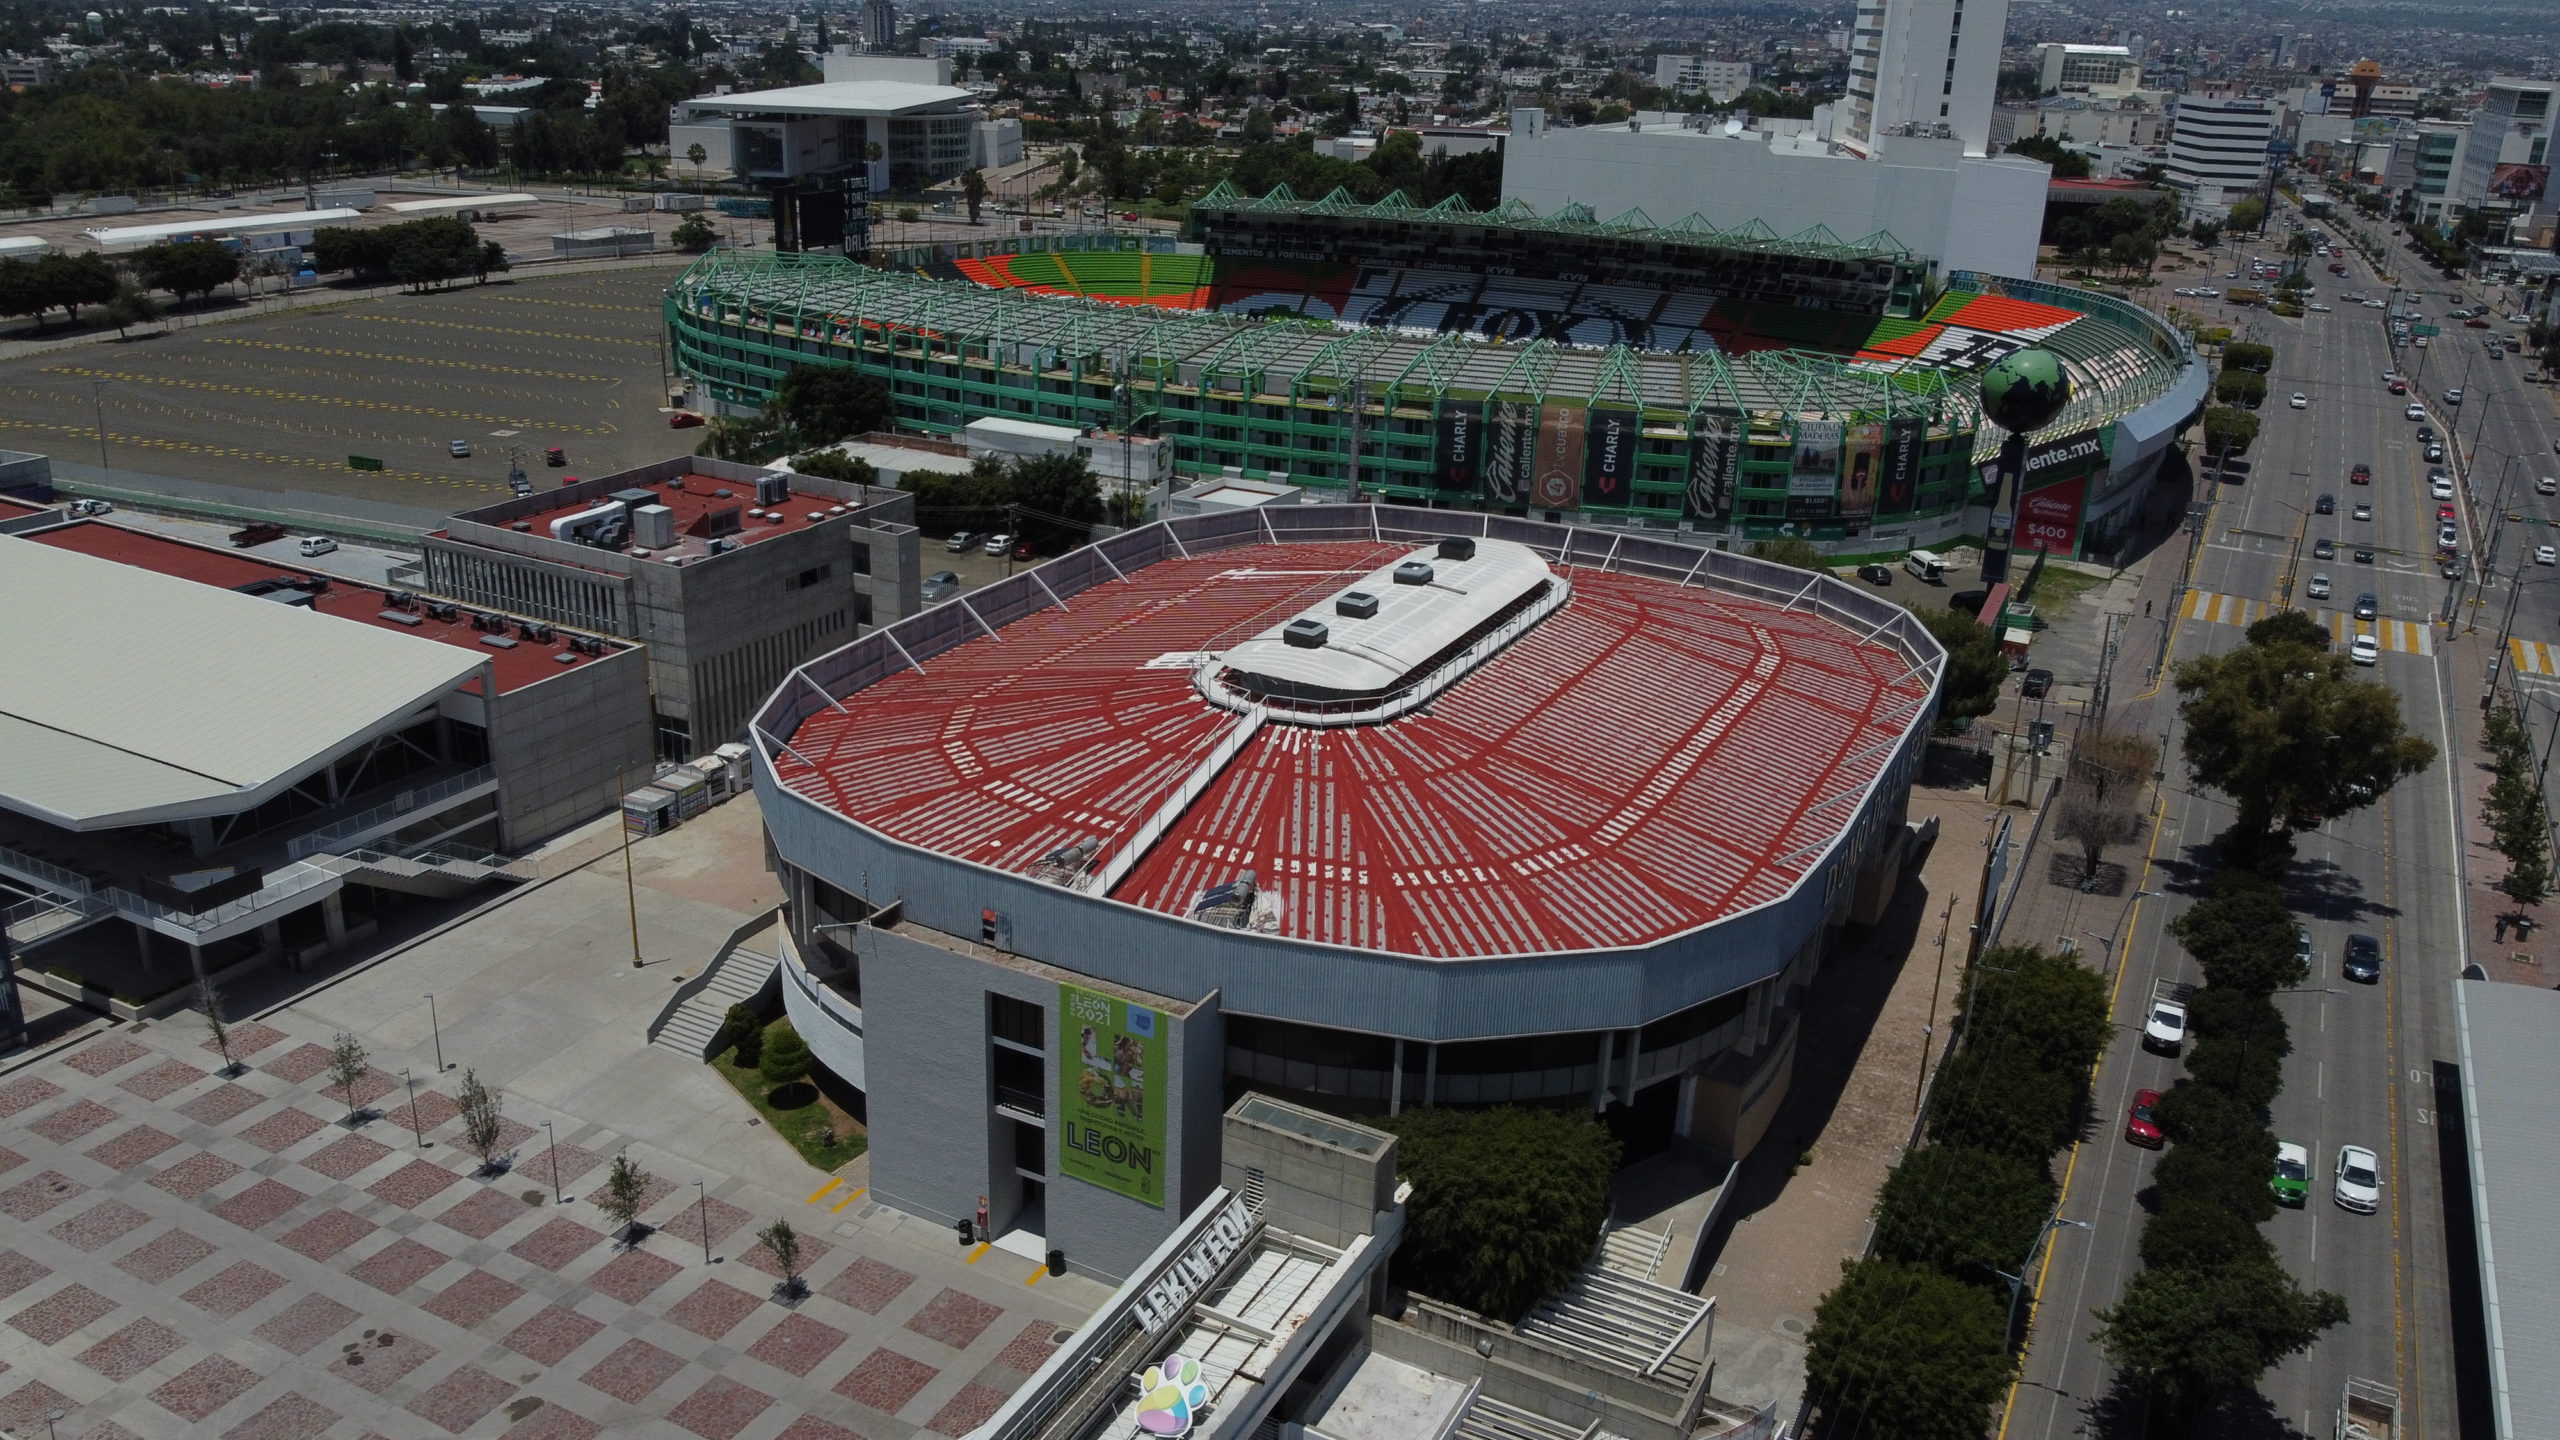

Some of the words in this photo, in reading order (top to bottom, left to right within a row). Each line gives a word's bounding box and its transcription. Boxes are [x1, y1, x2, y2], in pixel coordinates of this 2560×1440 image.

[843, 192, 849, 205] Y
[851, 191, 868, 204] DALE
[844, 208, 849, 221] Y
[852, 207, 868, 220] DALE
[845, 233, 870, 253] DALE
[1221, 248, 1264, 257] CEMENTOS
[1278, 251, 1325, 261] FORTALEZA
[1359, 257, 1407, 268] caliente.mx
[1423, 261, 1472, 272] caliente.mx
[1612, 277, 1661, 290] caliente.mx
[1679, 284, 1729, 297] caliente.mx
[1453, 409, 1468, 462] CHARLY
[1799, 422, 1841, 431] CIUDAD
[1520, 405, 1534, 479] caliente.mx
[1799, 432, 1840, 440] MADERAS
[1486, 400, 1520, 503] Caliente
[1603, 418, 1621, 473] CHARLY
[1896, 427, 1912, 480] CHARLY
[1687, 416, 1722, 520] Caliente
[1722, 422, 1741, 496] caliente.mx
[2027, 523, 2067, 539] $400
[1076, 1006, 1110, 1026] 2021
[1067, 1121, 1152, 1174] LEON
